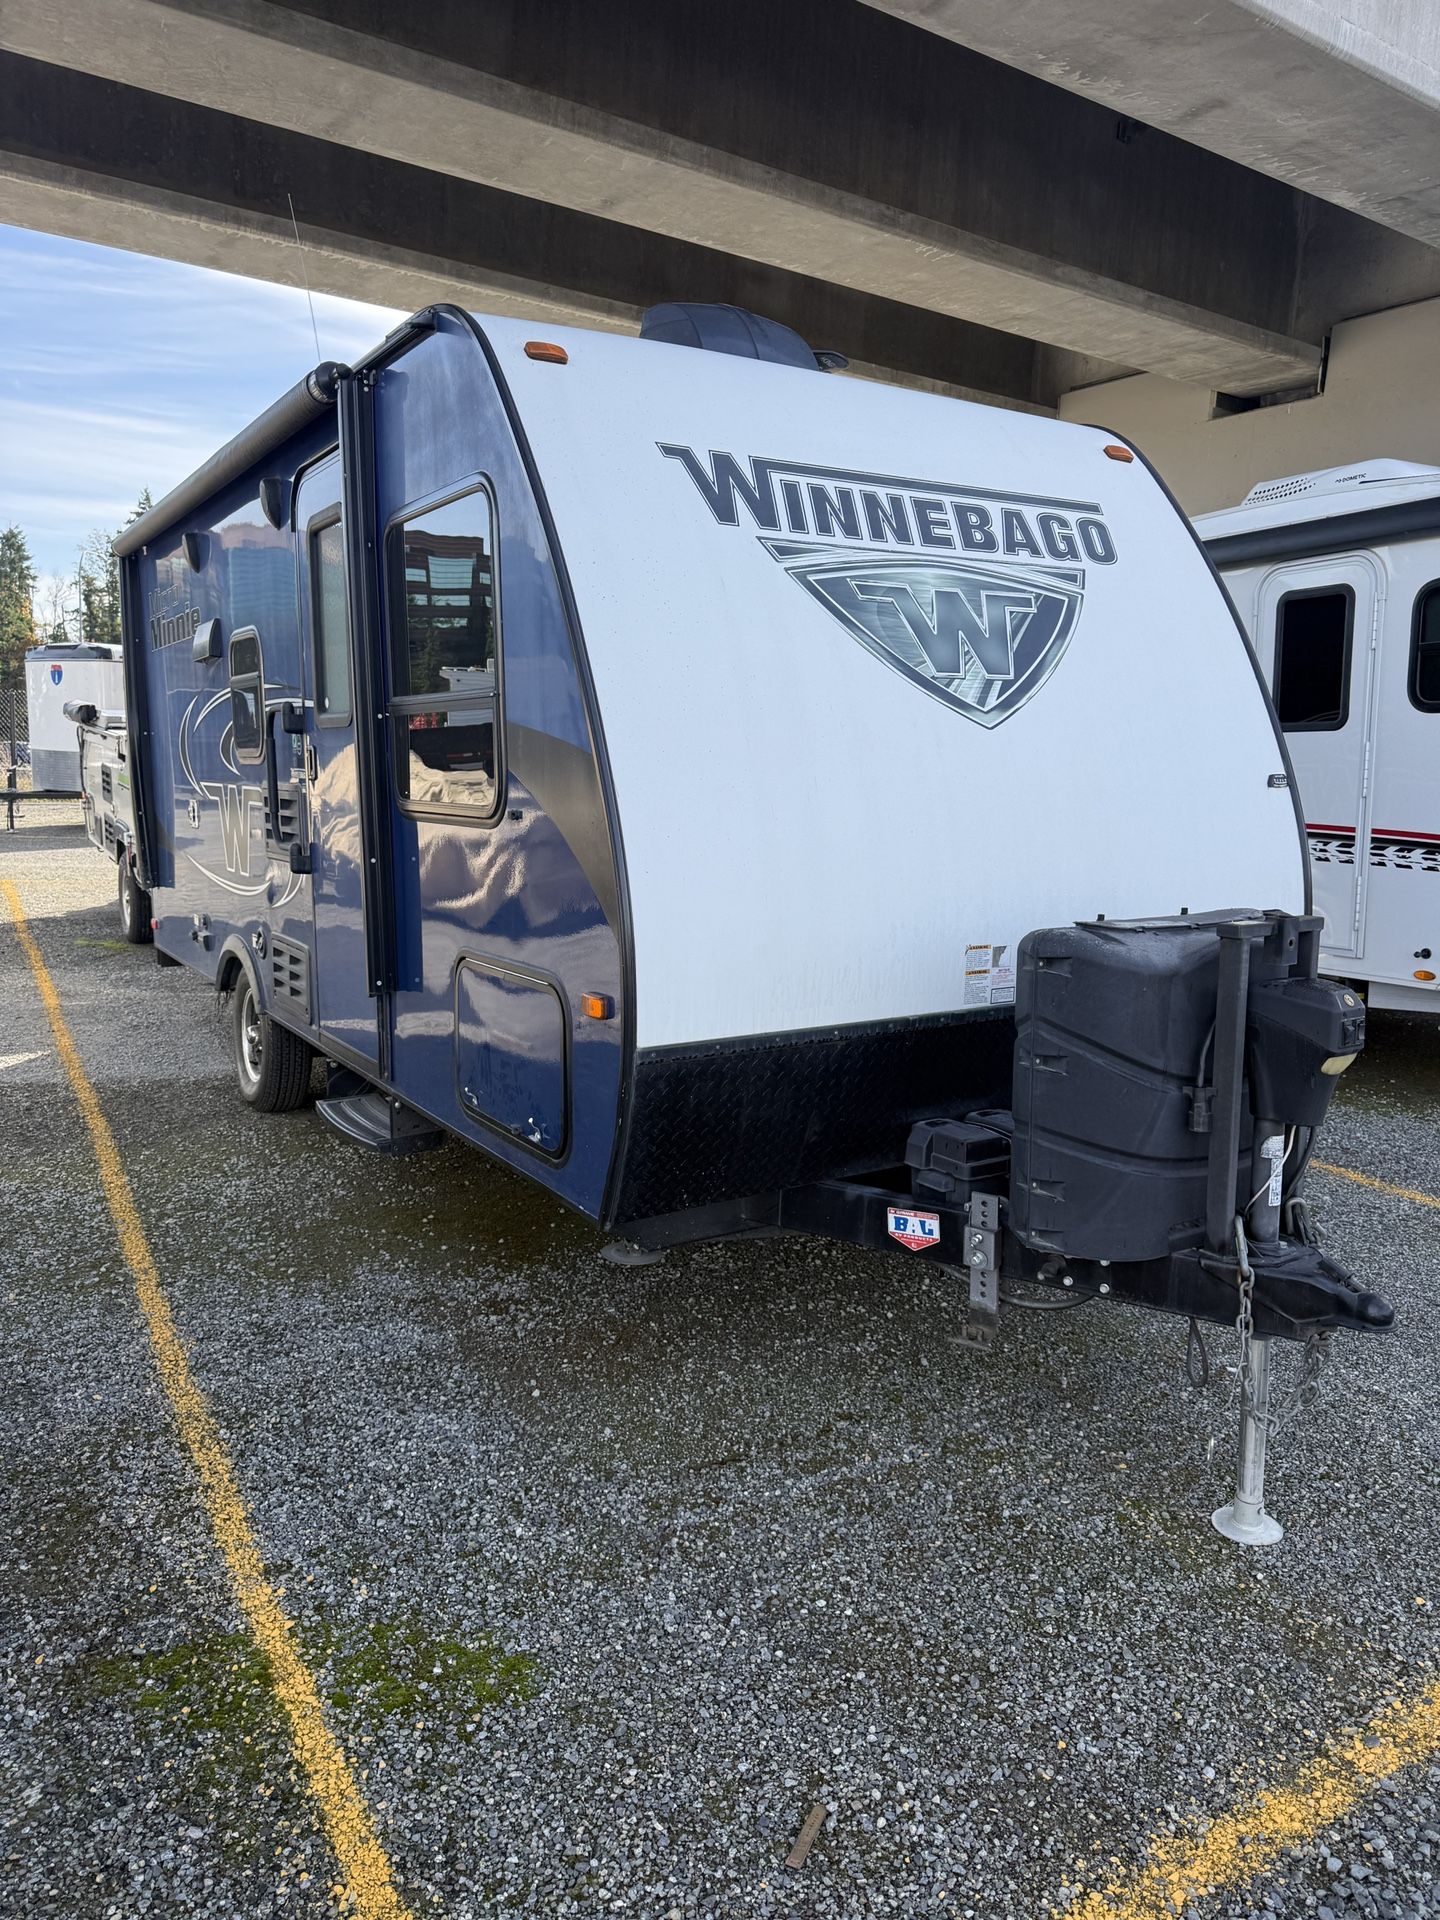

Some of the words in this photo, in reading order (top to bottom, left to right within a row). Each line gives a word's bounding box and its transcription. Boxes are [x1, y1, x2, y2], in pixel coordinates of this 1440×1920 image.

[655, 441, 1118, 566] WINNEBAGO
[1342, 473, 1367, 483] DOMETIC
[149, 601, 202, 653] Minnie
[849, 577, 1038, 680] W
[200, 781, 264, 877] W
[893, 1215, 934, 1237] BAL
[903, 1233, 933, 1242] PRODUCTS
